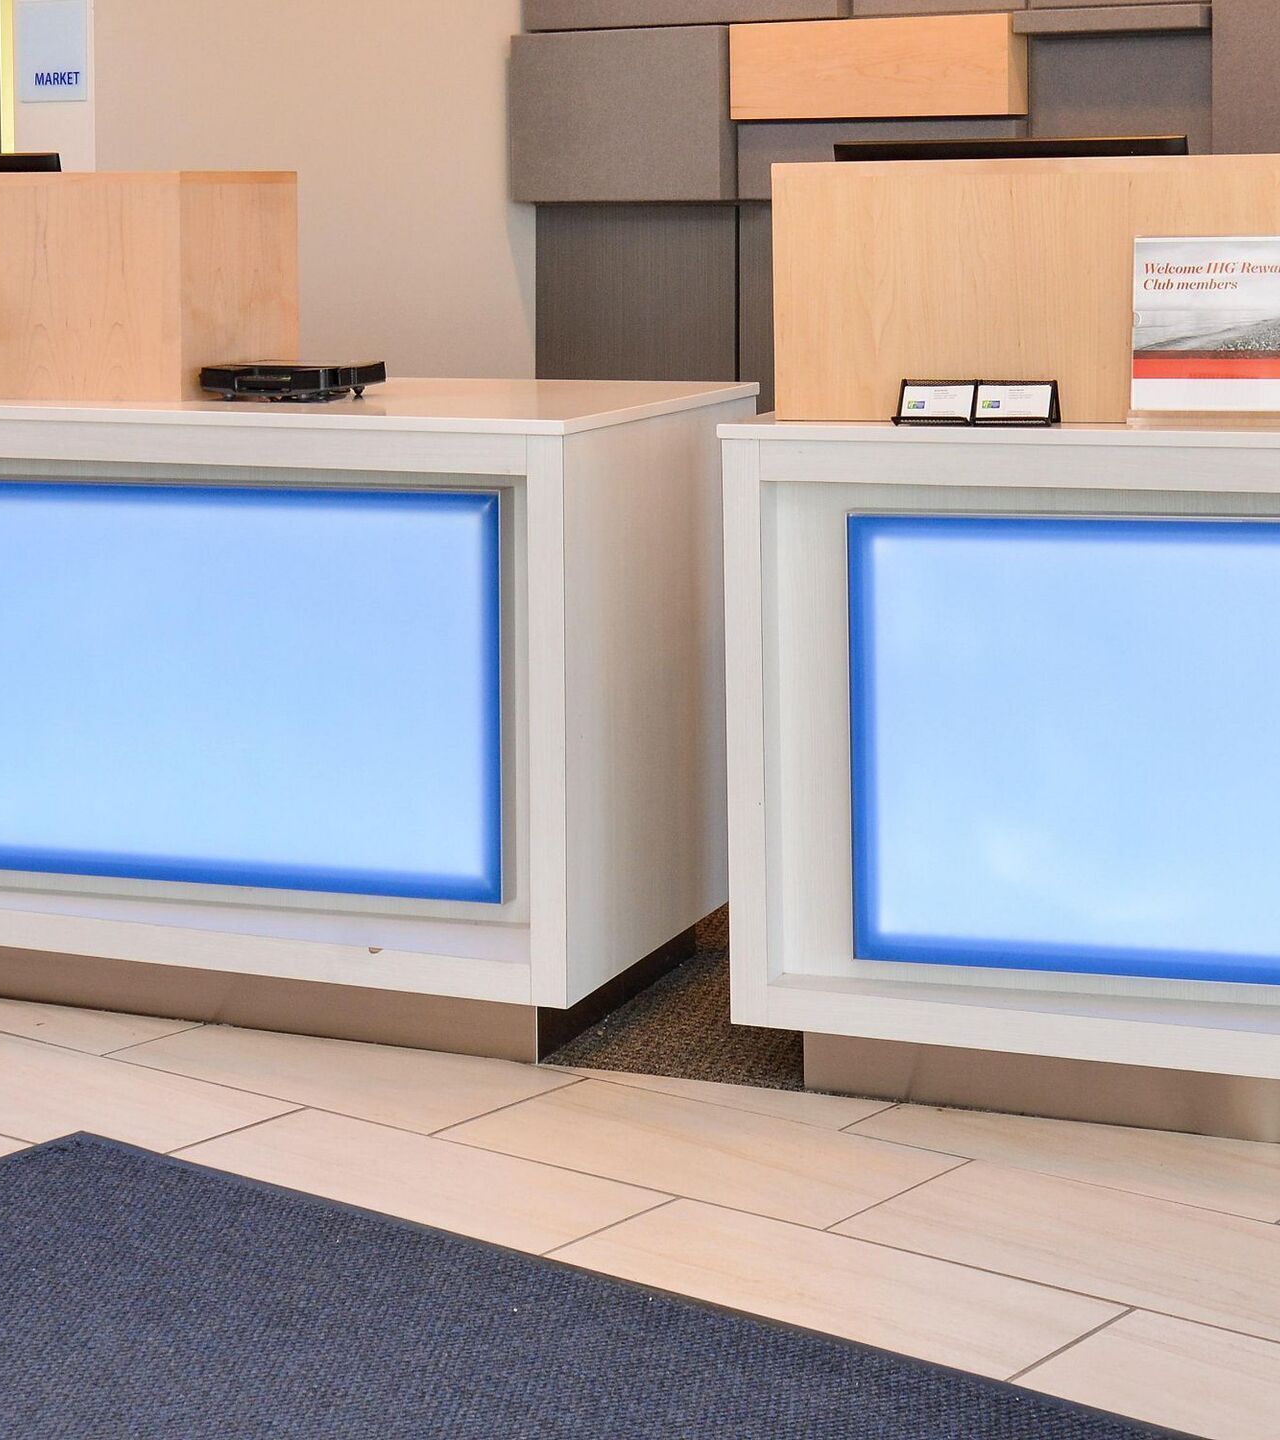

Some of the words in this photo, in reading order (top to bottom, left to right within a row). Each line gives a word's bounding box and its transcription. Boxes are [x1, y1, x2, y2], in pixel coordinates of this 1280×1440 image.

[34, 71, 80, 86] MARKET
[1144, 263, 1204, 275] Welcome
[1144, 278, 1174, 291] Club
[1177, 279, 1238, 290] members
